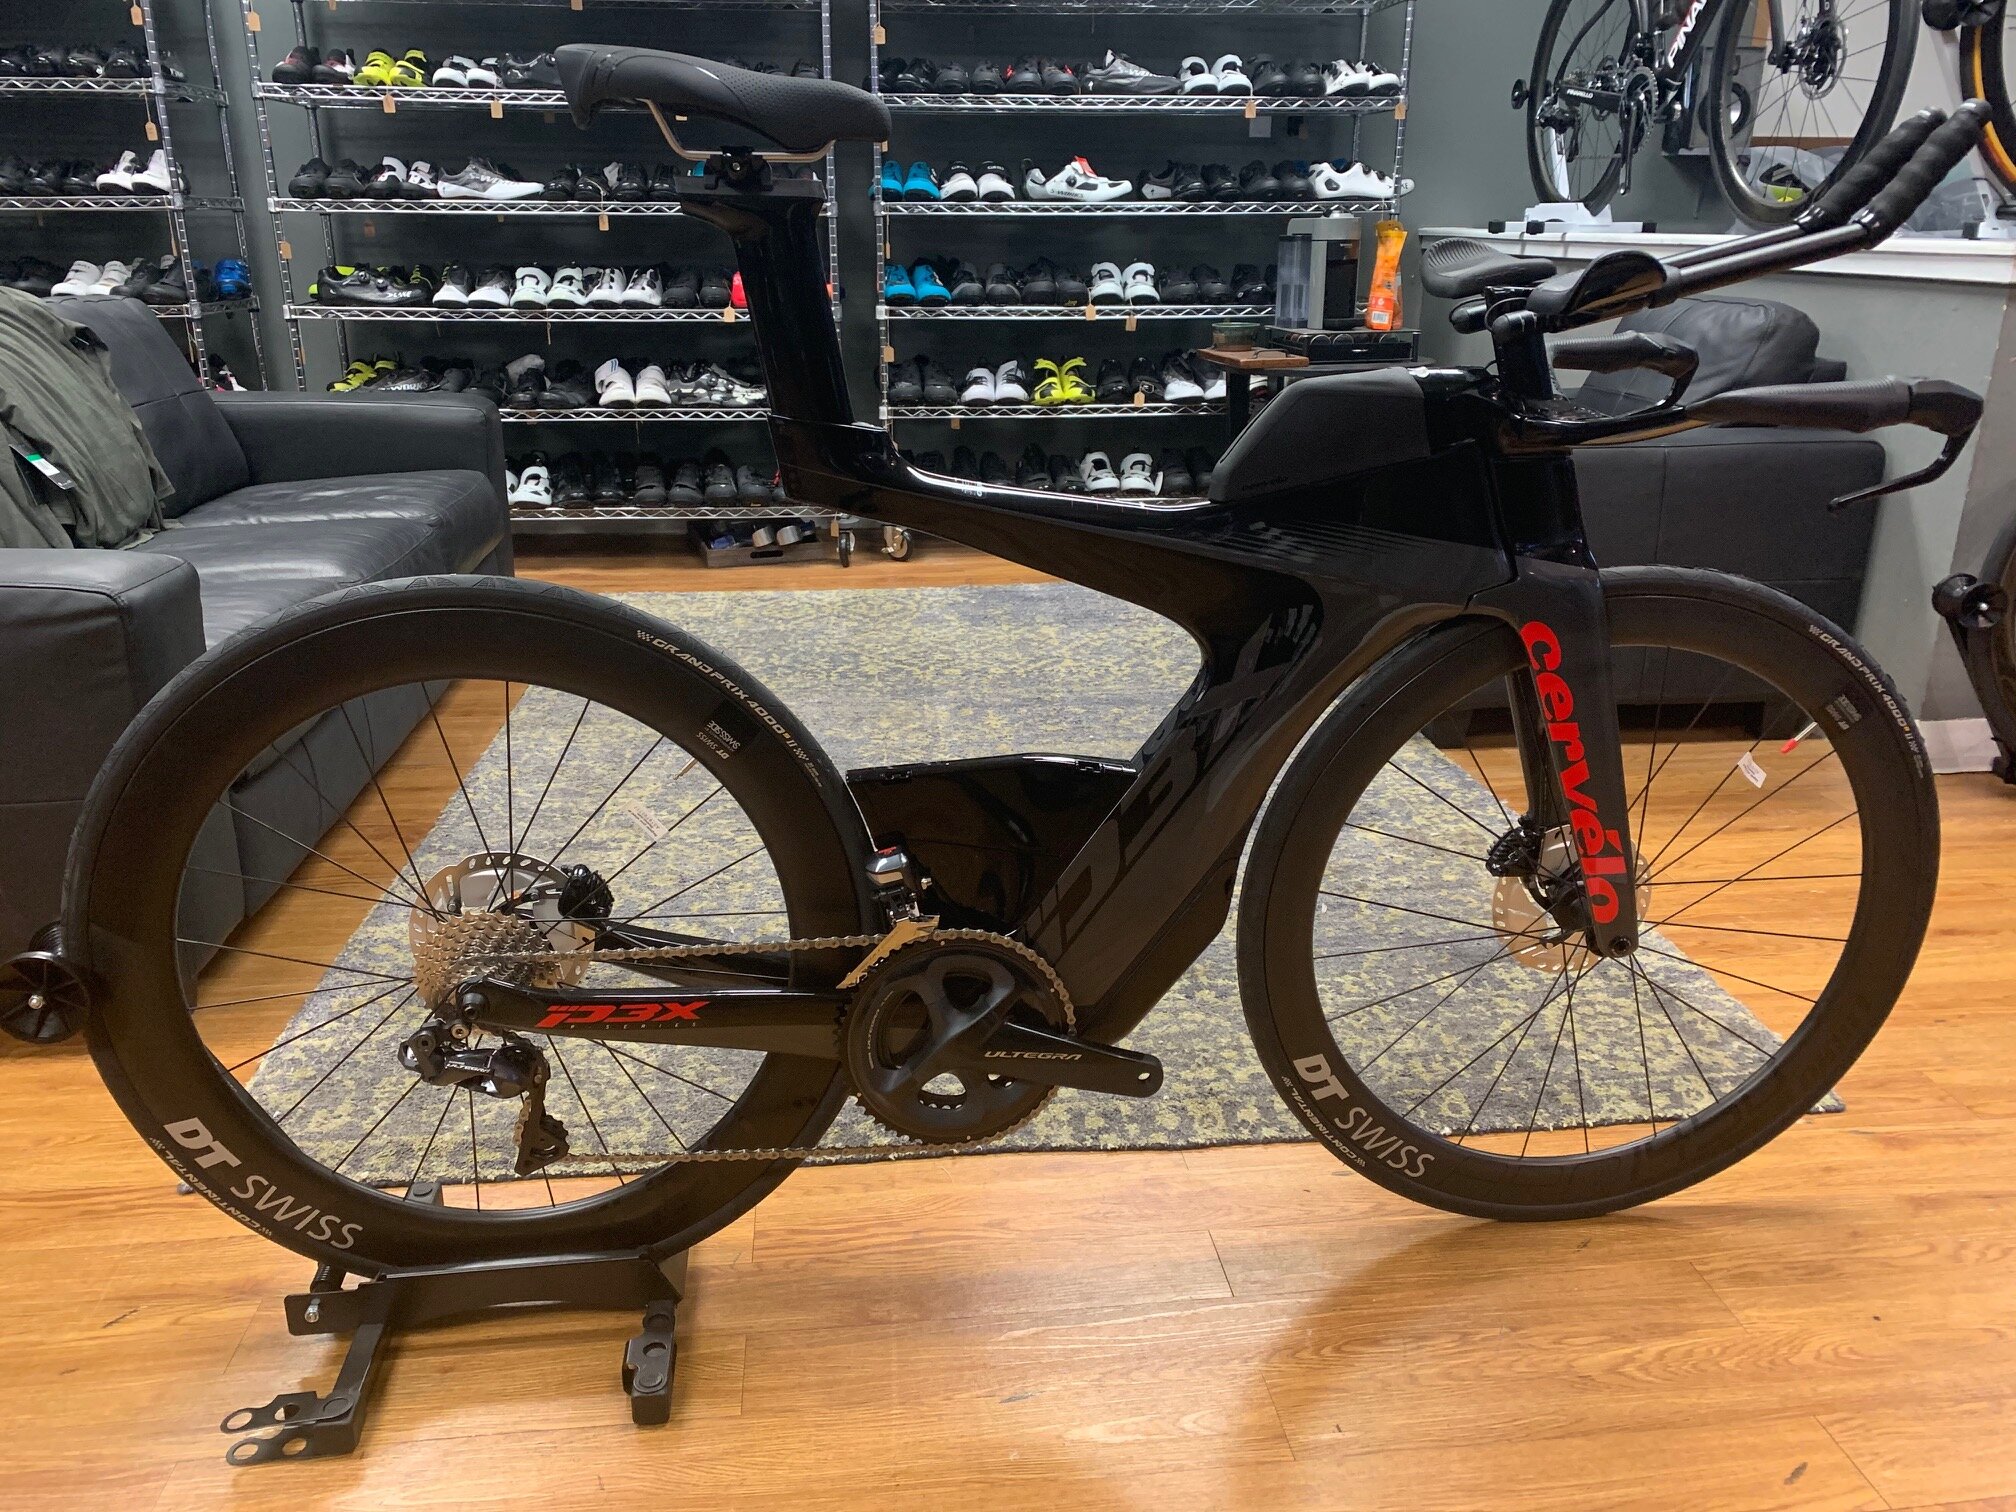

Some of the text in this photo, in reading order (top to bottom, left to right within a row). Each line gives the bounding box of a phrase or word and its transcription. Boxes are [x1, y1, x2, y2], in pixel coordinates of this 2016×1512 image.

[1668, 0, 1708, 68] PINA
[652, 637, 714, 674] GRAND
[710, 671, 750, 701] PRIX
[1819, 633, 1863, 668] GRAND
[1858, 665, 1887, 694] PRIX
[696, 731, 718, 750] SWISS
[1520, 621, 1628, 924] cervélo
[534, 1001, 711, 1028] P3X
[984, 1050, 1083, 1061] ULTEGRA
[1290, 1087, 1356, 1160] CONTINENTAL
[1293, 1053, 1435, 1178] DT SWISS
[163, 1116, 363, 1249] DT SWISS
[164, 1149, 261, 1229] CONTINENTAL
